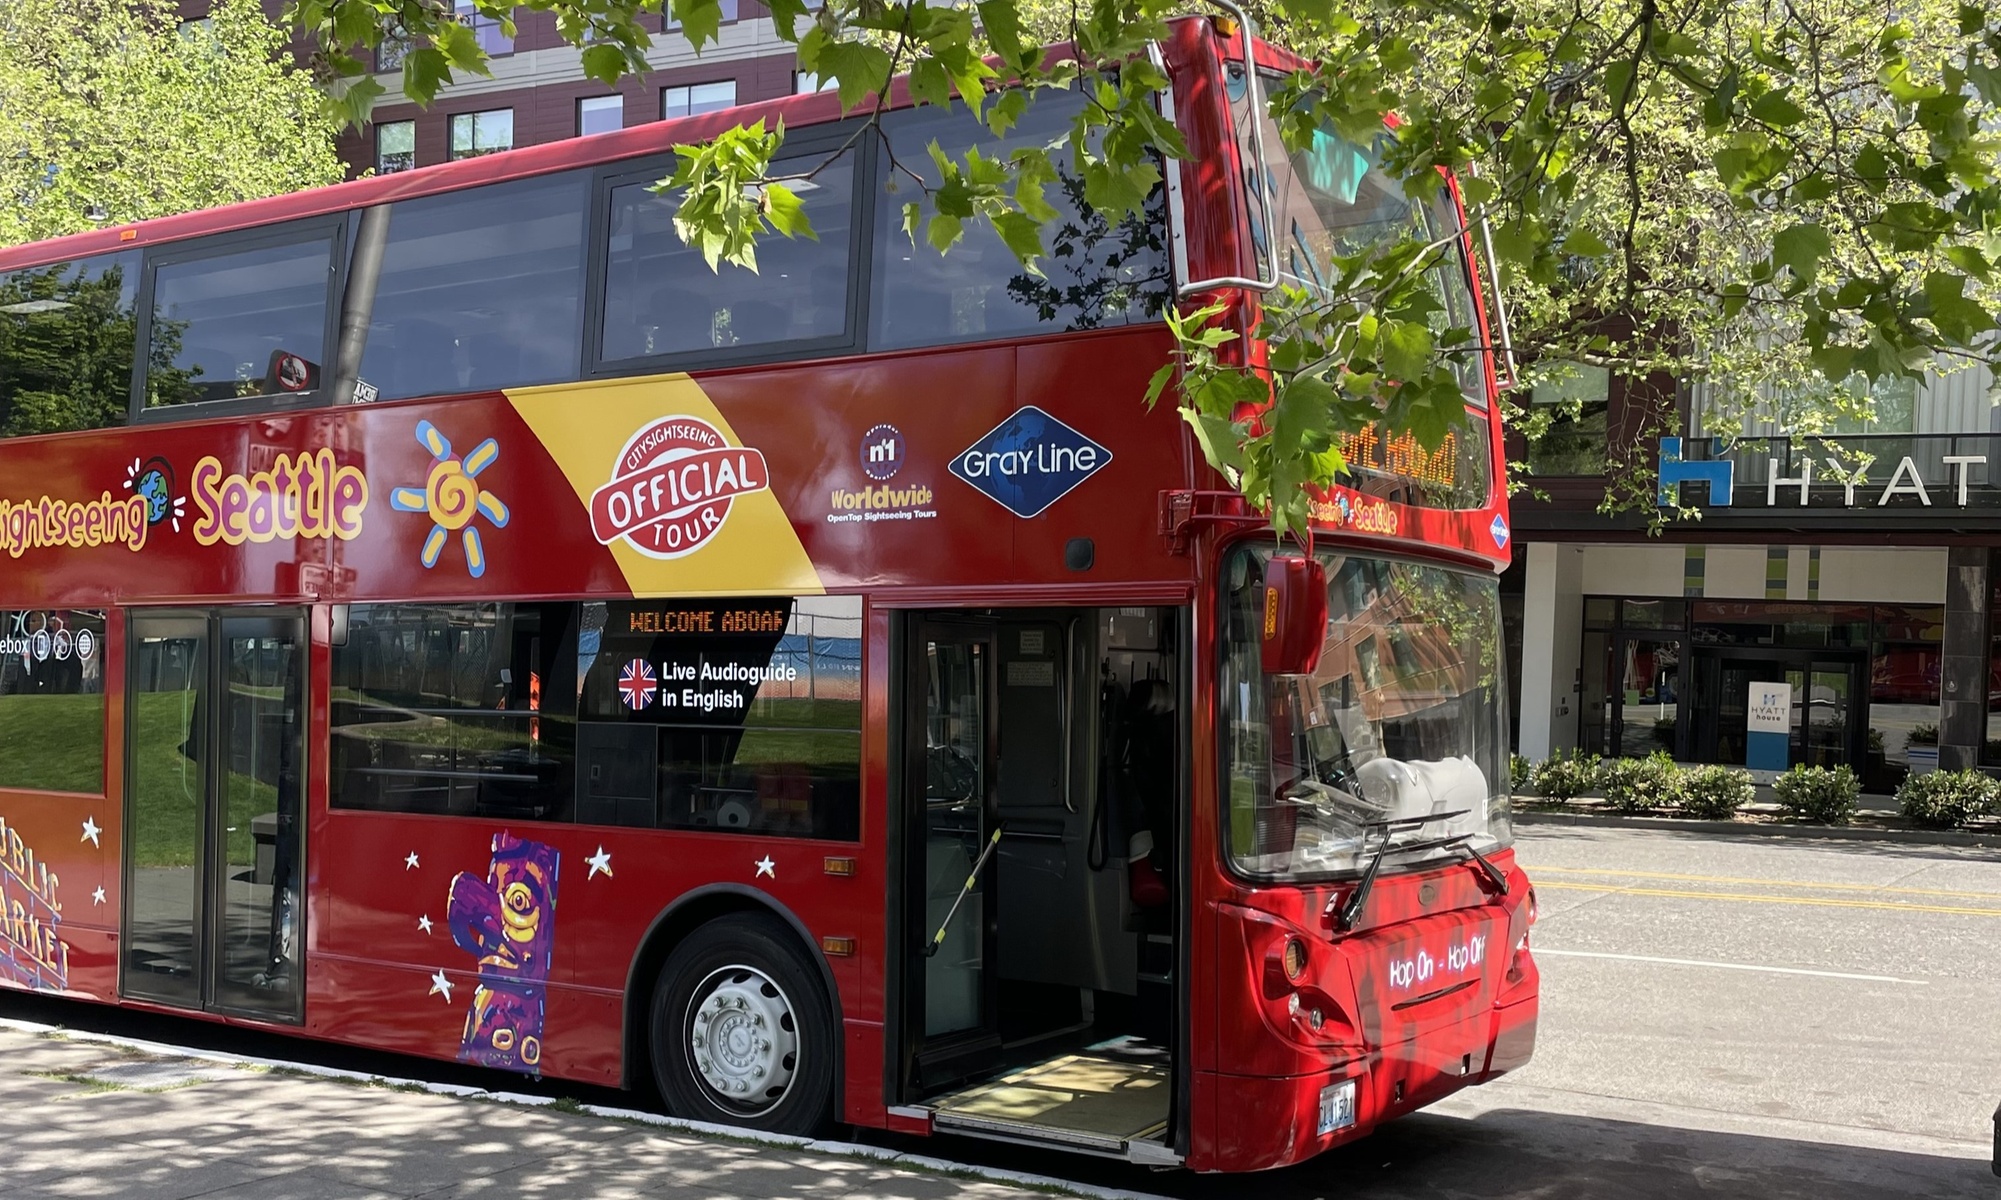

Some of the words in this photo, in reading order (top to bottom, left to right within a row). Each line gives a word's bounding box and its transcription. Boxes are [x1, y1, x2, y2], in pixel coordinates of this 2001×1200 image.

[626, 425, 717, 470] CITYSIGHTSEEING
[0, 491, 148, 558] ightseeing
[191, 447, 369, 546] Seattle
[607, 454, 758, 529] OFFICIAL
[831, 484, 933, 510] Worldwide
[653, 507, 720, 548] TOUR
[827, 513, 862, 524] OpenTop
[864, 511, 912, 522] Sightseeing
[913, 510, 937, 518] Tours
[1354, 496, 1398, 535] Seattle
[630, 611, 714, 632] WELCOME
[0, 633, 29, 654] ebox
[662, 661, 697, 681] Live
[701, 661, 797, 686] Audioguide
[662, 688, 677, 707] in
[682, 688, 744, 712] English
[1751, 706, 1787, 715] HYATT
[1756, 714, 1781, 722] house
[1389, 960, 1415, 988] Hop
[1417, 951, 1434, 981] On
[1448, 945, 1469, 972] Hop
[1470, 936, 1486, 965] Off
